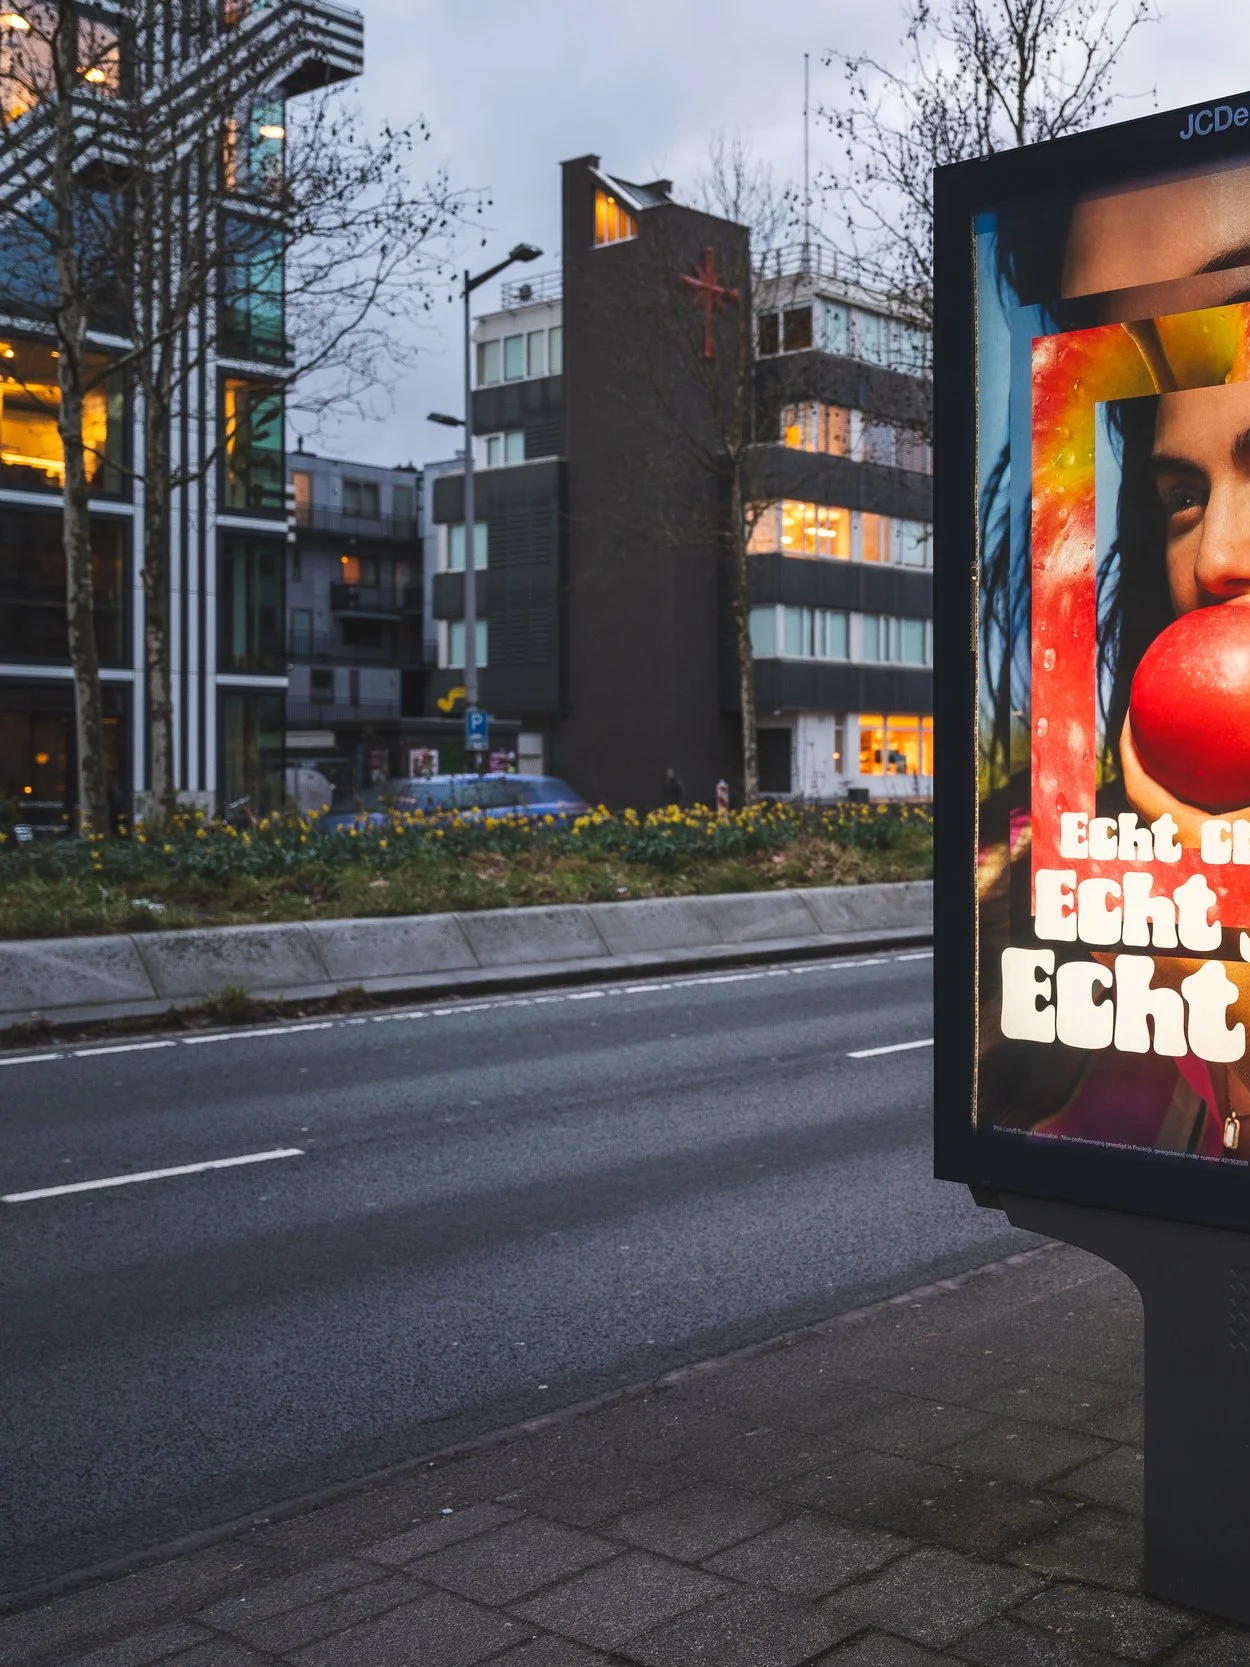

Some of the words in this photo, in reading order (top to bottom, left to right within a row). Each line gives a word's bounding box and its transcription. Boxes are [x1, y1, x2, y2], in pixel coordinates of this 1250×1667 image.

[1060, 812, 1182, 863] Echt
[1034, 869, 1223, 951] Echt
[1001, 947, 1246, 1063] Echt
[1033, 1131, 1058, 1139] Association
